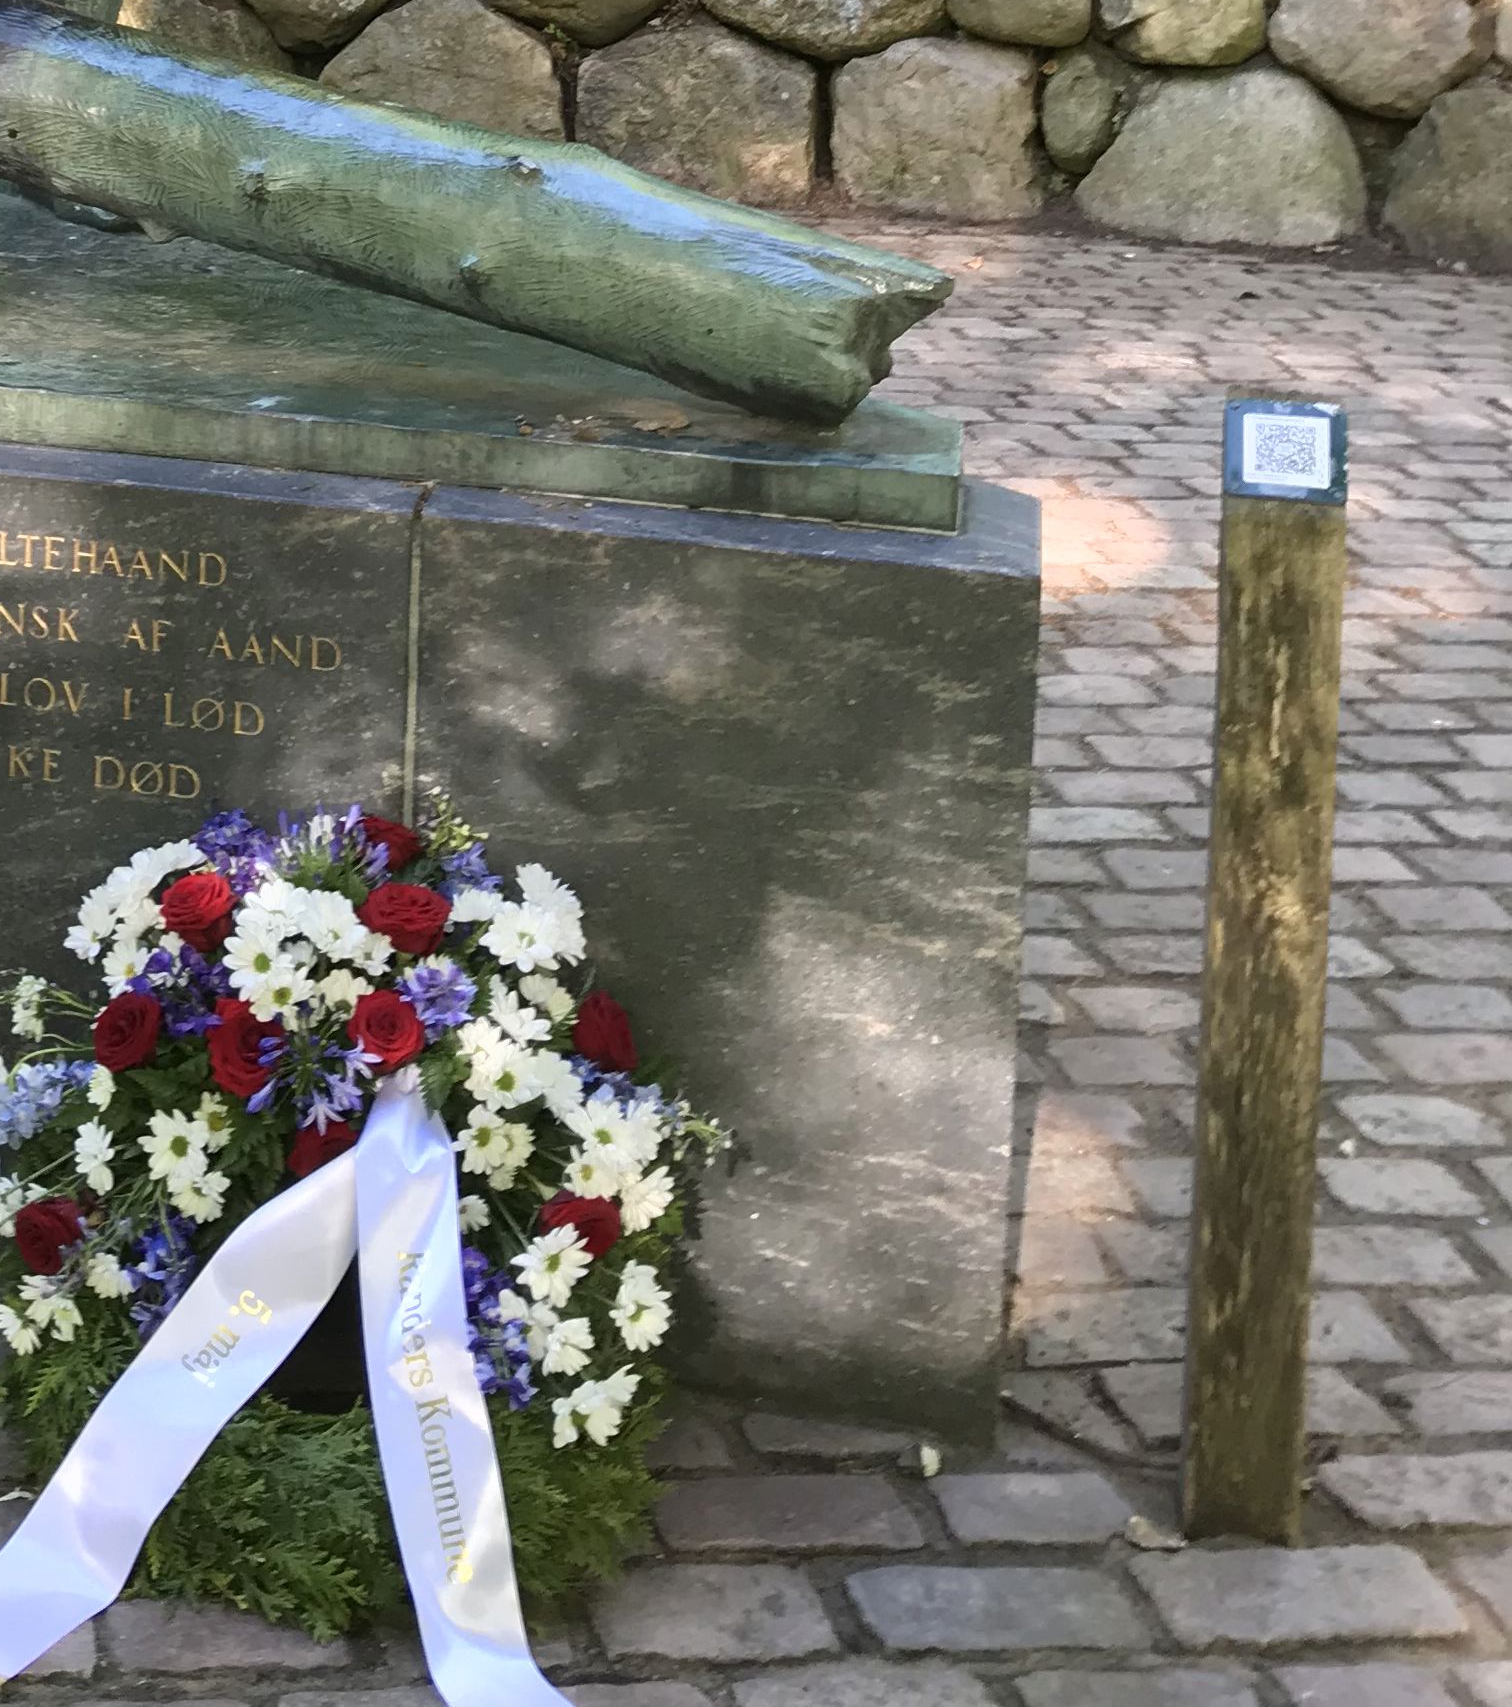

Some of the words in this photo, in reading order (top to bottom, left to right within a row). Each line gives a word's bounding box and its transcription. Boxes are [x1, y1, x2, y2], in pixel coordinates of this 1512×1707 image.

[121, 618, 175, 653] AF
[208, 627, 342, 672] AAND
[0, 672, 90, 717] LOV
[123, 688, 133, 721] I
[163, 693, 265, 737] LØD
[94, 755, 201, 800] DØD
[181, 1323, 241, 1388] maj
[415, 1394, 475, 1585] Kommune
